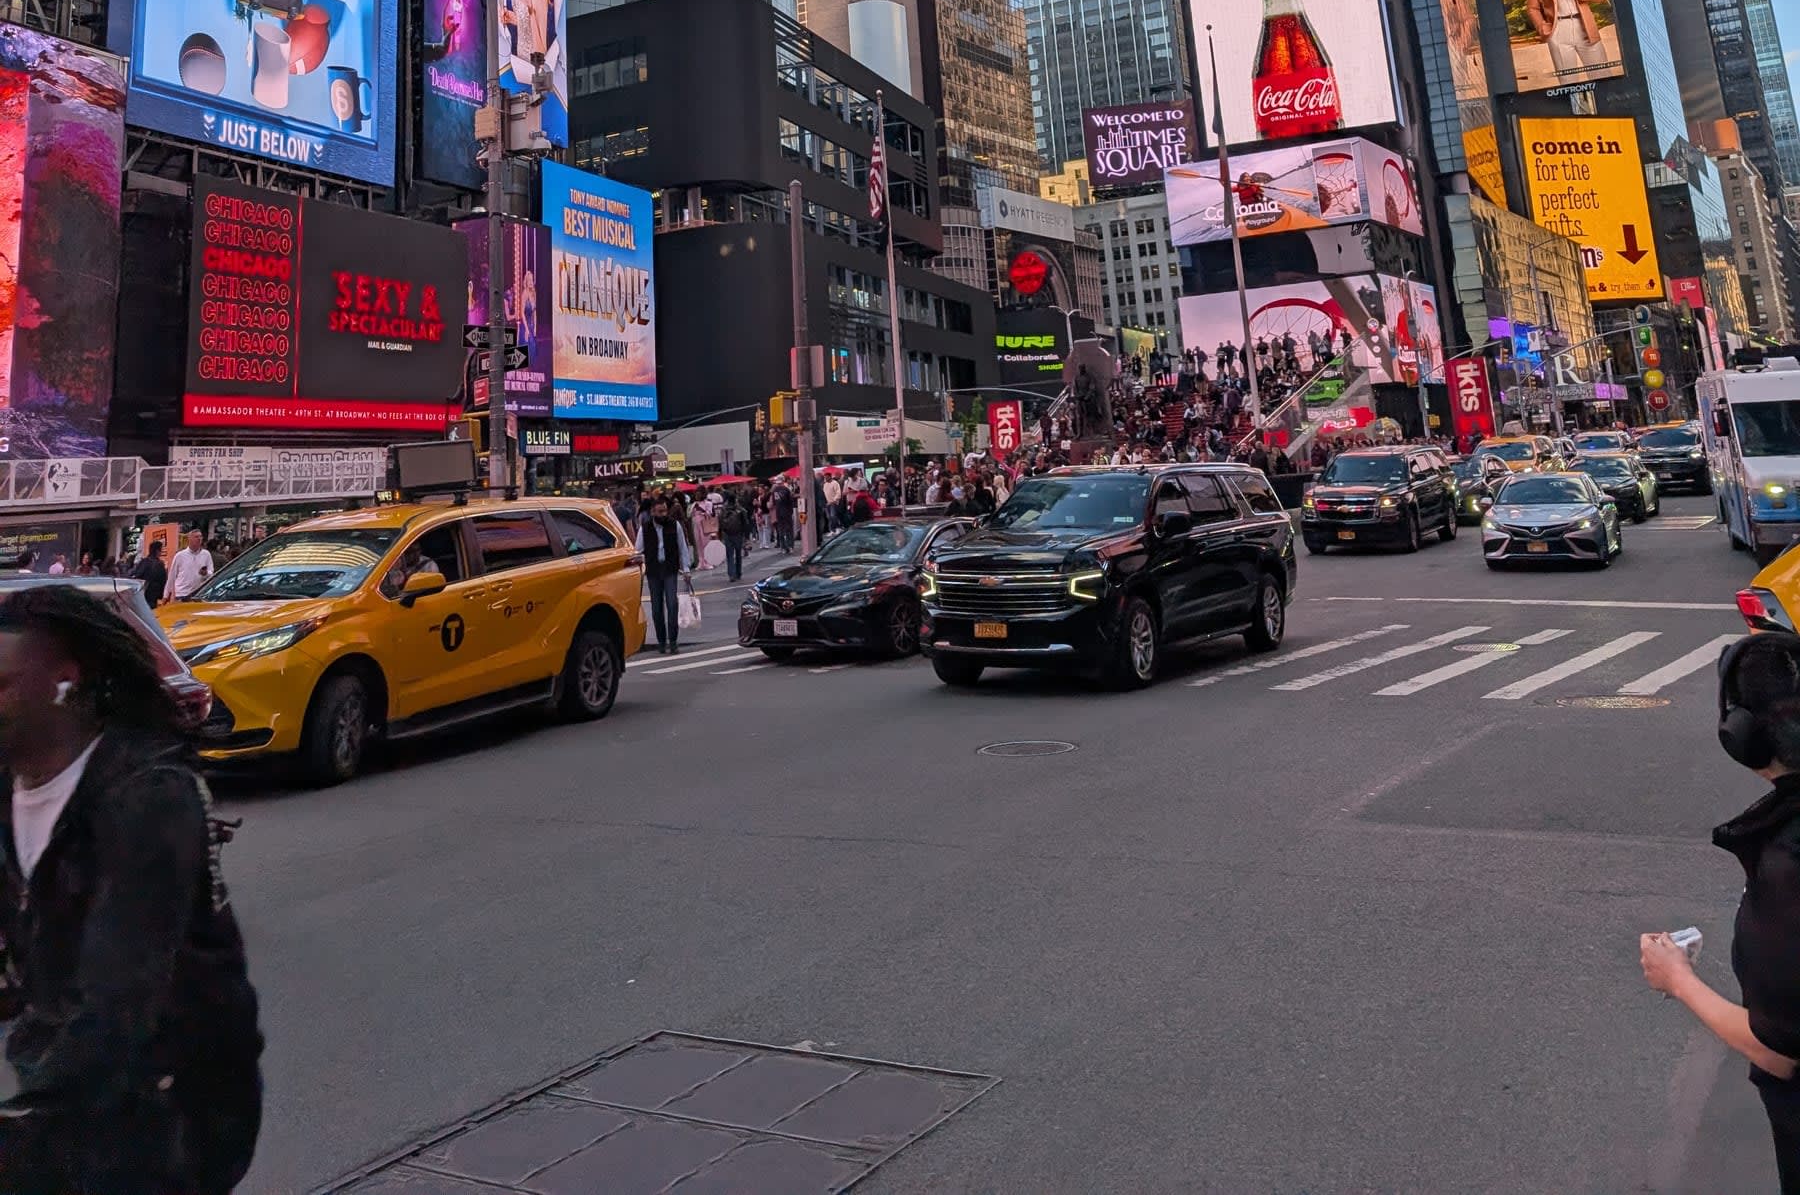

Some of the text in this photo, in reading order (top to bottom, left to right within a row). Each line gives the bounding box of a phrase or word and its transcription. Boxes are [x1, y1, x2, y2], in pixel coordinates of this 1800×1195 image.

[1258, 76, 1336, 117] Coca-Cola
[1091, 109, 1184, 127] WELCOME TO
[1270, 109, 1327, 122] ORIGINAL TASTE
[218, 118, 311, 164] JUST BELOW
[1131, 127, 1186, 147] TIMES
[1531, 135, 1622, 155] come in
[1096, 143, 1187, 178] SQUARE
[1535, 157, 1590, 181] for the
[570, 188, 586, 205] TONY
[1539, 186, 1600, 217] perfect
[1010, 204, 1034, 220] HYATT
[563, 206, 636, 250] BEST MUSICAL
[1598, 282, 1607, 292] &
[419, 284, 440, 321] &
[471, 331, 487, 342] ONE
[576, 335, 628, 360] ON BROADWAY
[1554, 354, 1590, 386] R
[1455, 361, 1482, 412] tkts
[200, 406, 253, 416] AMBASSADOR
[256, 407, 286, 417] THEATRE
[295, 409, 312, 418] 49TH
[326, 410, 334, 419] AT
[336, 410, 370, 419] BROADWAY
[378, 411, 387, 420] NO
[389, 411, 403, 420] FEES
[404, 412, 412, 420] AT
[413, 412, 424, 421] THE
[425, 413, 436, 421] BOX
[996, 404, 1016, 450] tkts
[526, 431, 551, 445] BLUE
[554, 431, 570, 445] FIN
[189, 448, 244, 458] SPORTS FAN SHOP
[278, 451, 333, 477] GRAND
[594, 459, 645, 478] KLIKTIX
[653, 460, 668, 469] TICKET
